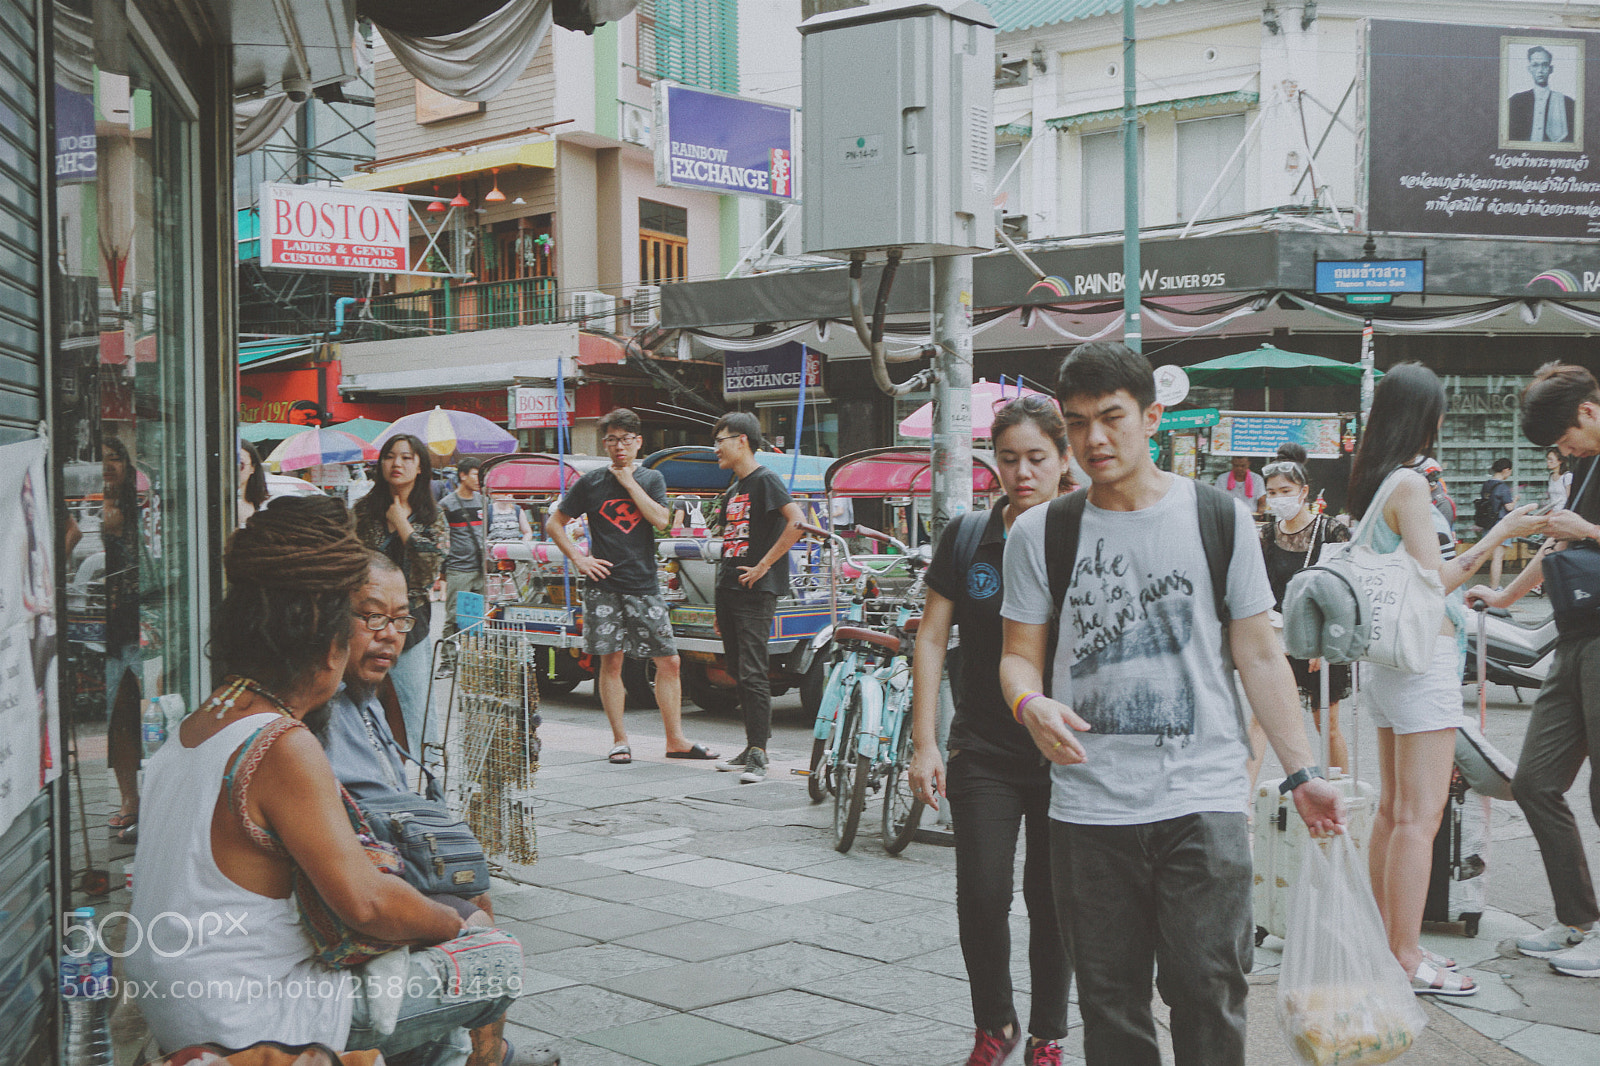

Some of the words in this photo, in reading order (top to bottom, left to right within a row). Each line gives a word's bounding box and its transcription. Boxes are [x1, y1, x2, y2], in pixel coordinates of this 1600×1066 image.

[671, 141, 729, 163] RAINBOW
[671, 157, 769, 190] EXCHANGE
[273, 199, 402, 242] BOSTON
[283, 241, 331, 253] LADIES
[336, 245, 348, 254] &
[352, 246, 395, 257] GENTS
[280, 253, 337, 264] CUSTOM
[342, 256, 398, 268] TAILORS
[1334, 263, 1407, 279] ถนนข้าวสาร
[1074, 269, 1158, 296] RAINBW
[1160, 275, 1199, 290] SILVER
[1201, 273, 1225, 287] 925
[1389, 279, 1405, 287] San
[726, 364, 769, 376] RAINBOW
[726, 372, 802, 389] EXCHANGE
